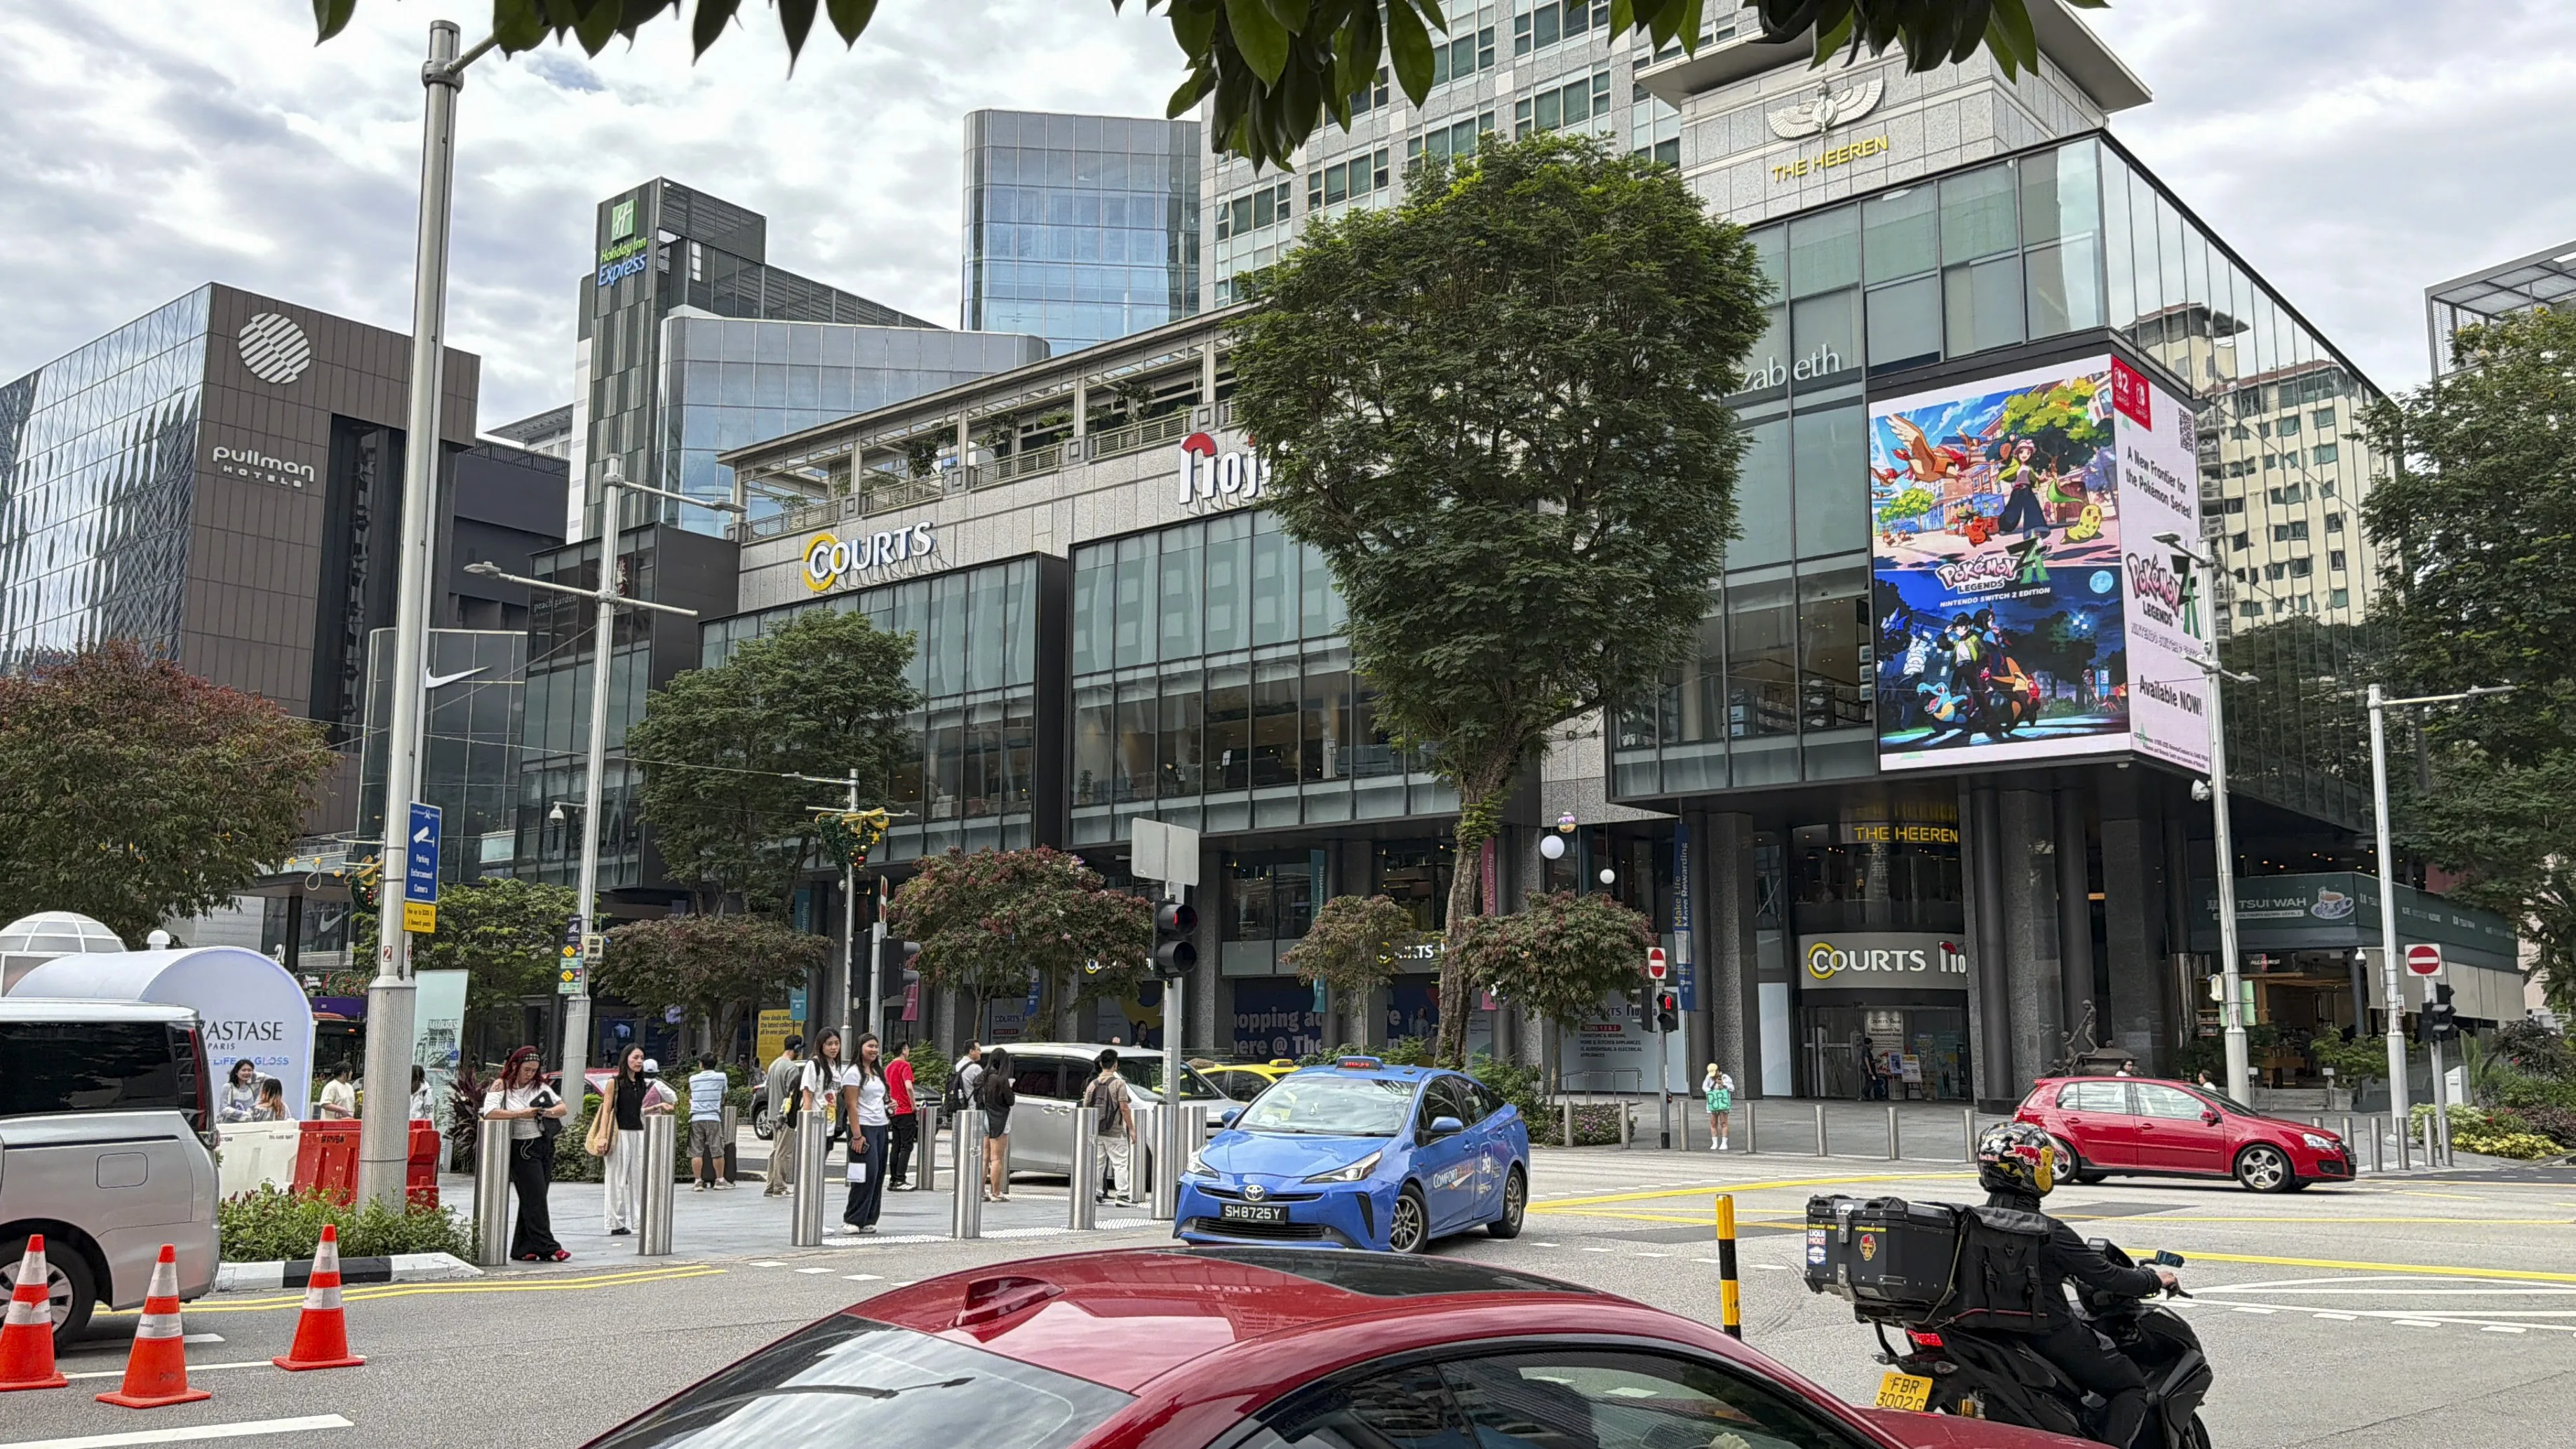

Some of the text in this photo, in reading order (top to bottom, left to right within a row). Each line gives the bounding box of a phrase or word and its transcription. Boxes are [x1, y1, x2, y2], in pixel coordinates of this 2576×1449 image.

[1772, 135, 1889, 184] THE HEEREN
[600, 236, 647, 264] Holiday Inn
[598, 253, 647, 286] Express
[1726, 343, 1842, 397] zabeth
[213, 446, 314, 483] pullman
[223, 464, 302, 487] HOTELS
[2127, 445, 2187, 494] A New Frontier for
[2126, 468, 2192, 520] the Pokémon Series!
[808, 520, 934, 579] COURTS
[1937, 555, 2018, 588] Pokémon
[1940, 597, 1978, 608] NINTENDO
[1980, 592, 2010, 602] SWITCH
[2018, 587, 2051, 598] EDITION
[1958, 581, 2004, 593] LEGENDS
[533, 594, 577, 613] peach garden
[2142, 600, 2173, 628] LEGENDS
[2139, 674, 2202, 717] Available NOW!
[1853, 826, 1959, 843] THE HEEREN
[415, 854, 430, 866] Parking
[1680, 842, 1689, 897] Rewarding
[413, 884, 429, 894] Camera
[2238, 897, 2307, 910] TSUI WAH
[801, 901, 810, 935] warding
[384, 946, 392, 962] 2
[1811, 948, 1927, 973] COURTS
[994, 1015, 1019, 1023] COURTS
[200, 1020, 283, 1041] ASTASE
[1272, 1036, 1289, 1056] @
[254, 1056, 289, 1065] GLOSS
[1225, 1205, 1280, 1220] SH8725Y
[1890, 1377, 1920, 1394] FBR
[1876, 1391, 1924, 1412] 3002G
